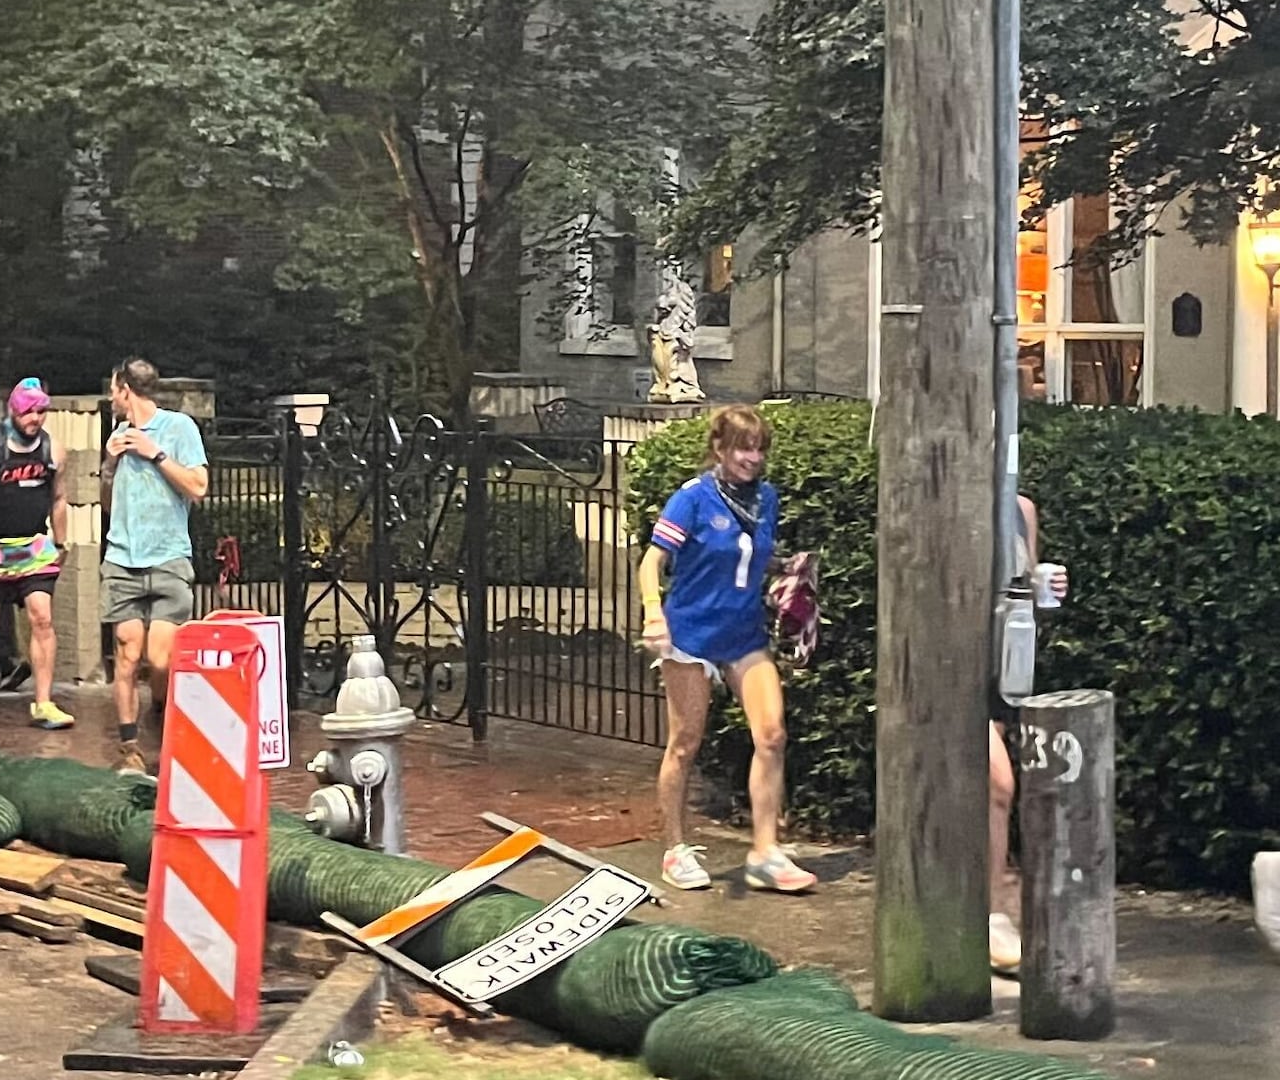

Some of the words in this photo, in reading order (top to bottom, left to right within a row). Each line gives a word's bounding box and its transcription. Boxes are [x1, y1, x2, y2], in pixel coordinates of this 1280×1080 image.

[735, 532, 753, 588] 1
[474, 892, 625, 989] SIDEWALK
[477, 895, 589, 968] CLOSED
